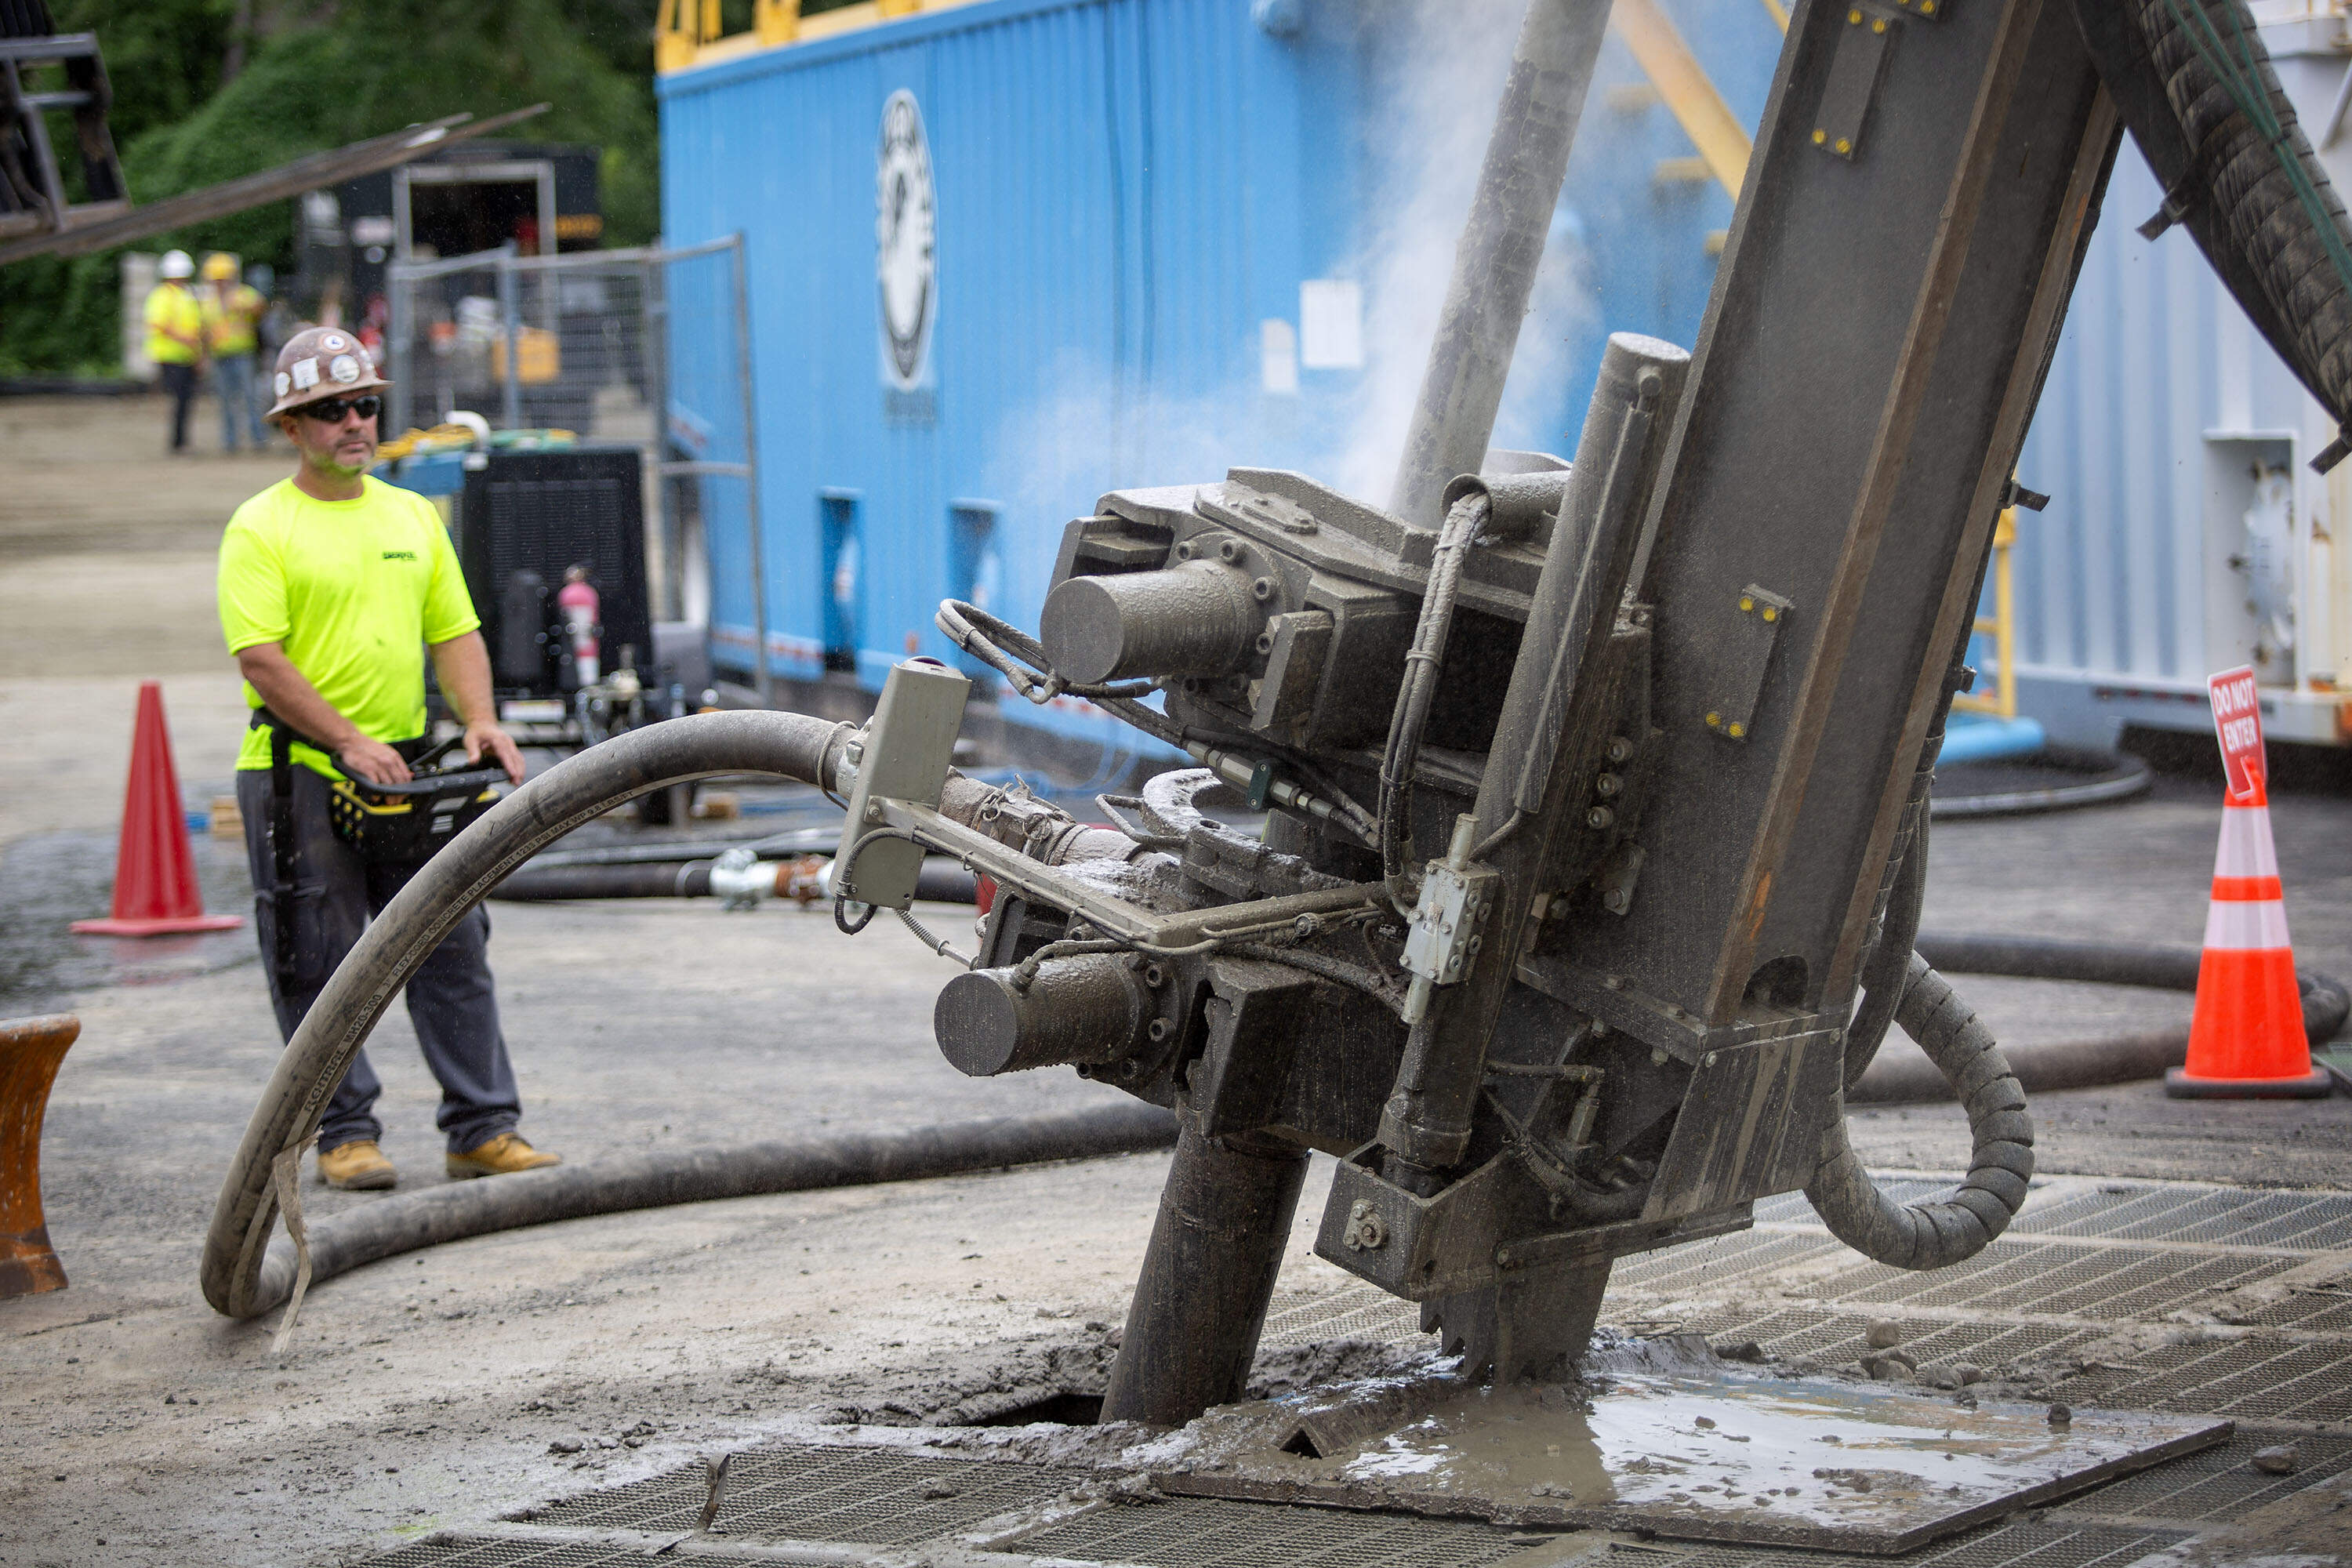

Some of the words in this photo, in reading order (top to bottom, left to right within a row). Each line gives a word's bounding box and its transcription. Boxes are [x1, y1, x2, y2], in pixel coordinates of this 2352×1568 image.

[2212, 683, 2231, 716] DO
[2230, 677, 2255, 710] NOT
[2222, 715, 2257, 753] ENTER
[428, 895, 470, 934] CONCRETE
[467, 855, 515, 896] PLACEMENT
[535, 832, 551, 844] PSI
[551, 820, 572, 834] MAX
[571, 811, 586, 822] WP
